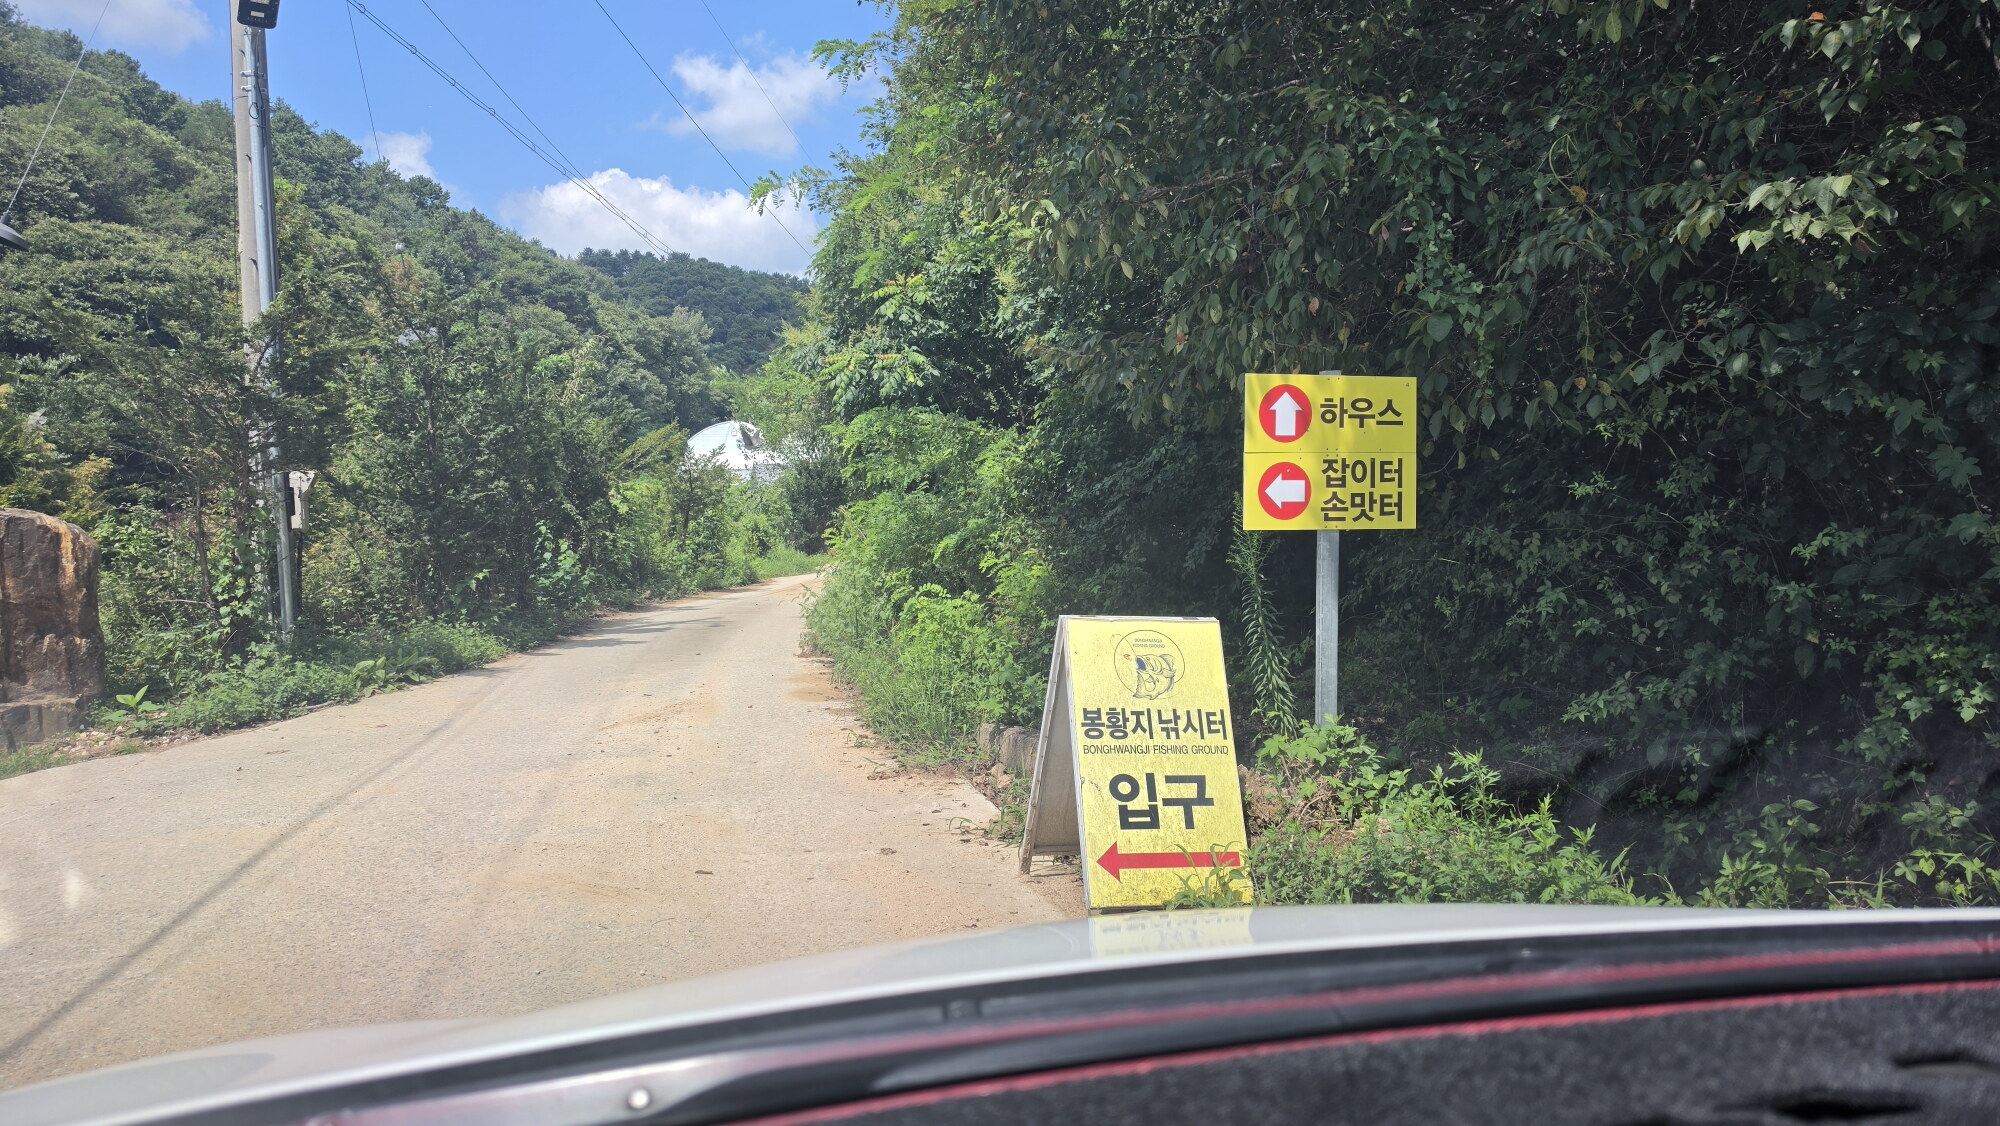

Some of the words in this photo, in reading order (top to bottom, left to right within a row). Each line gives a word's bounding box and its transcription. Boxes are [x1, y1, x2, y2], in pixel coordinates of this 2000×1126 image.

[1320, 397, 1403, 428] 하우스
[1321, 458, 1403, 488] 잡이터
[1321, 491, 1403, 522] 손맛터
[1081, 707, 1154, 740] 봉황지
[1157, 709, 1227, 740] 낚시터
[1083, 744, 1150, 755] BONGHWANGJI
[1153, 745, 1188, 755] FISHING
[1191, 745, 1229, 756] GROUND
[1108, 773, 1215, 830] 입구
